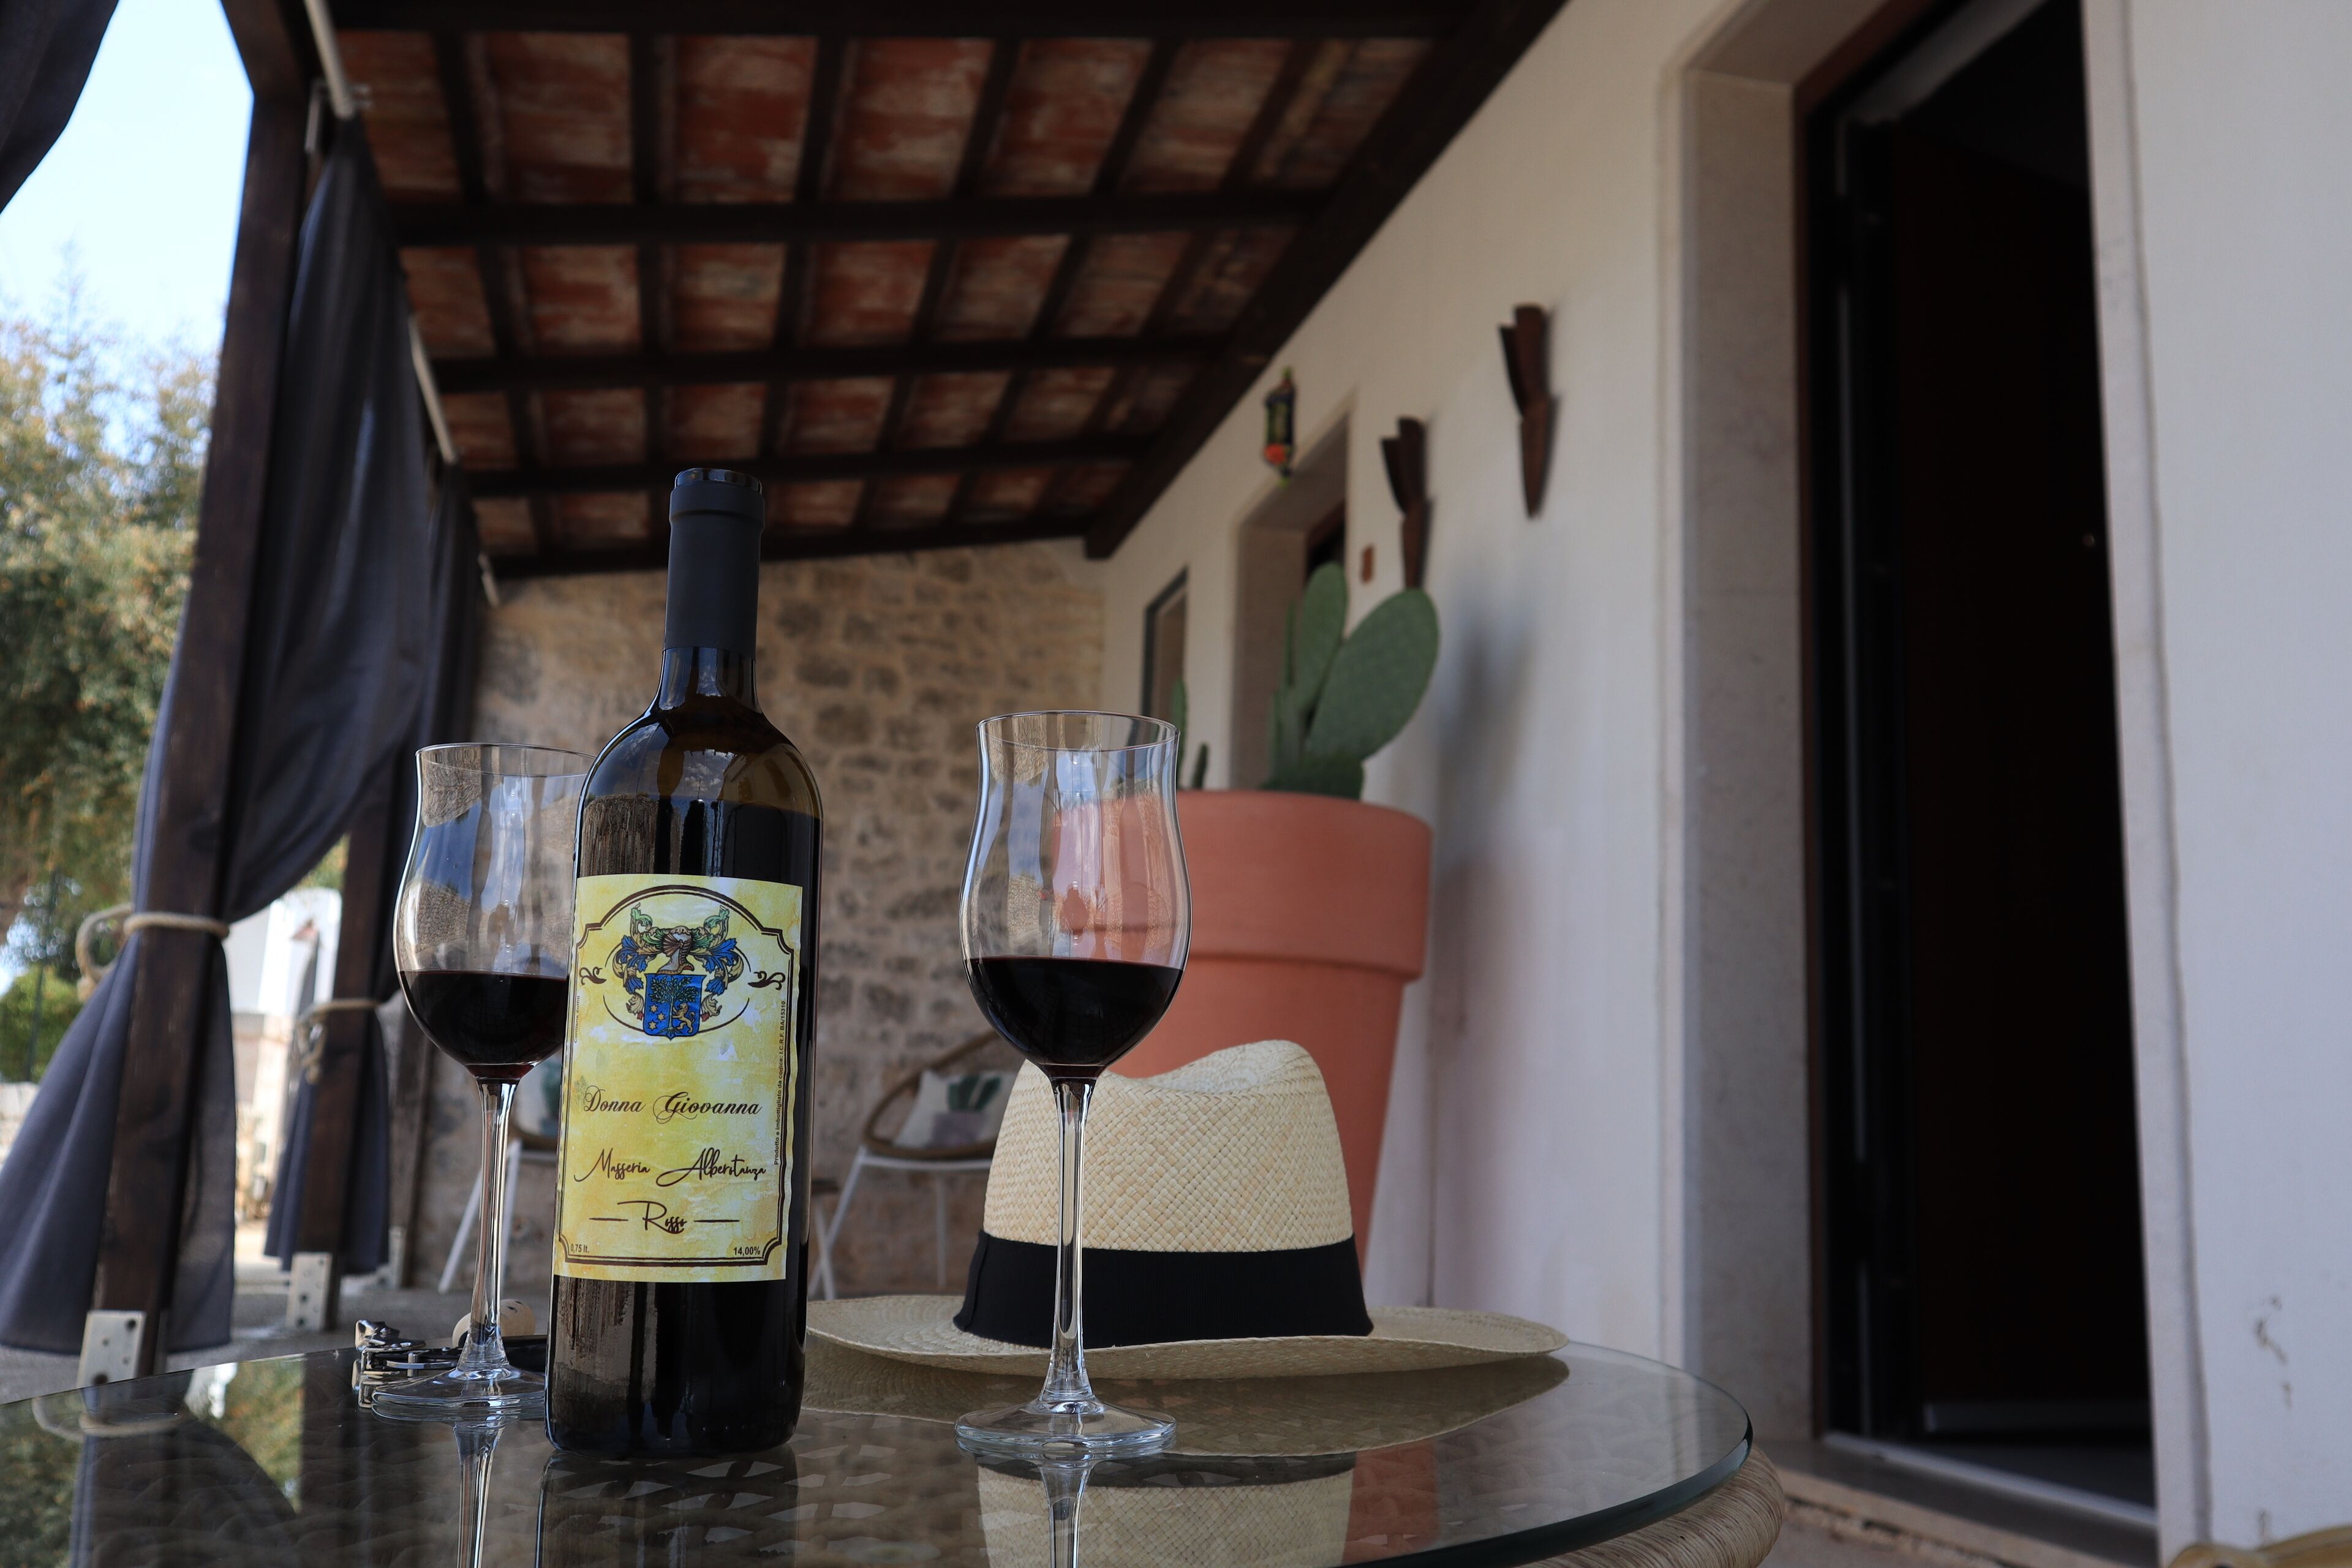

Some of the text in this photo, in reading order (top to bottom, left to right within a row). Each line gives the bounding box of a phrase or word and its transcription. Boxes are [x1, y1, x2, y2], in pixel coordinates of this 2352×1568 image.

[584, 1085, 763, 1124] Donna Giovanna
[574, 1147, 766, 1187] Masseria Alberotanza
[617, 1200, 688, 1234] Rosso
[570, 1243, 582, 1253] 0,75
[733, 1246, 761, 1256] 14,00%
